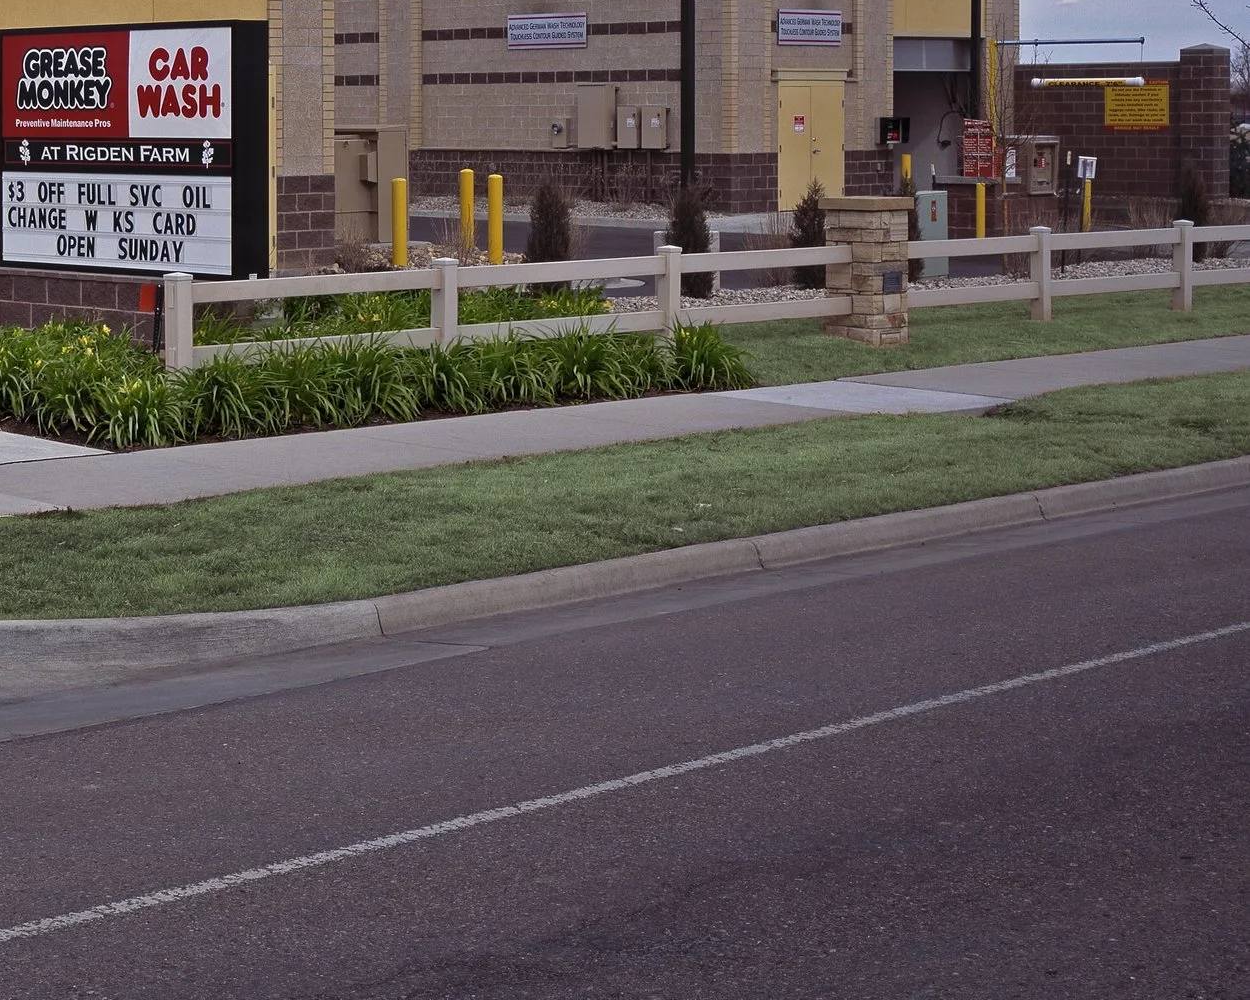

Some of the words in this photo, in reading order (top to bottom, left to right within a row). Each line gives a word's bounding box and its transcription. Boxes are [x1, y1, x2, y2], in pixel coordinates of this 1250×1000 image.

[560, 21, 585, 29] TECHNOLOGY
[23, 47, 106, 79] GREASE
[148, 46, 209, 81] CAR
[17, 77, 112, 109] MONKEY
[136, 84, 221, 118] WASH
[16, 119, 50, 128] Preventive
[51, 119, 93, 128] Maintenance
[94, 119, 111, 128] Pros
[41, 147, 61, 160] AT
[66, 145, 134, 162] RIGDEN
[139, 145, 190, 162] FARM
[8, 181, 25, 202] $3
[38, 182, 65, 203] OFF
[78, 183, 116, 205] FULL
[130, 184, 162, 207] SVC
[182, 185, 210, 208] OIL
[8, 207, 67, 229] CHANGE
[85, 210, 98, 231] W
[113, 211, 134, 232] KS
[153, 212, 196, 235] CARD
[57, 234, 95, 257] OPEN
[118, 238, 183, 262] SUNDAY
